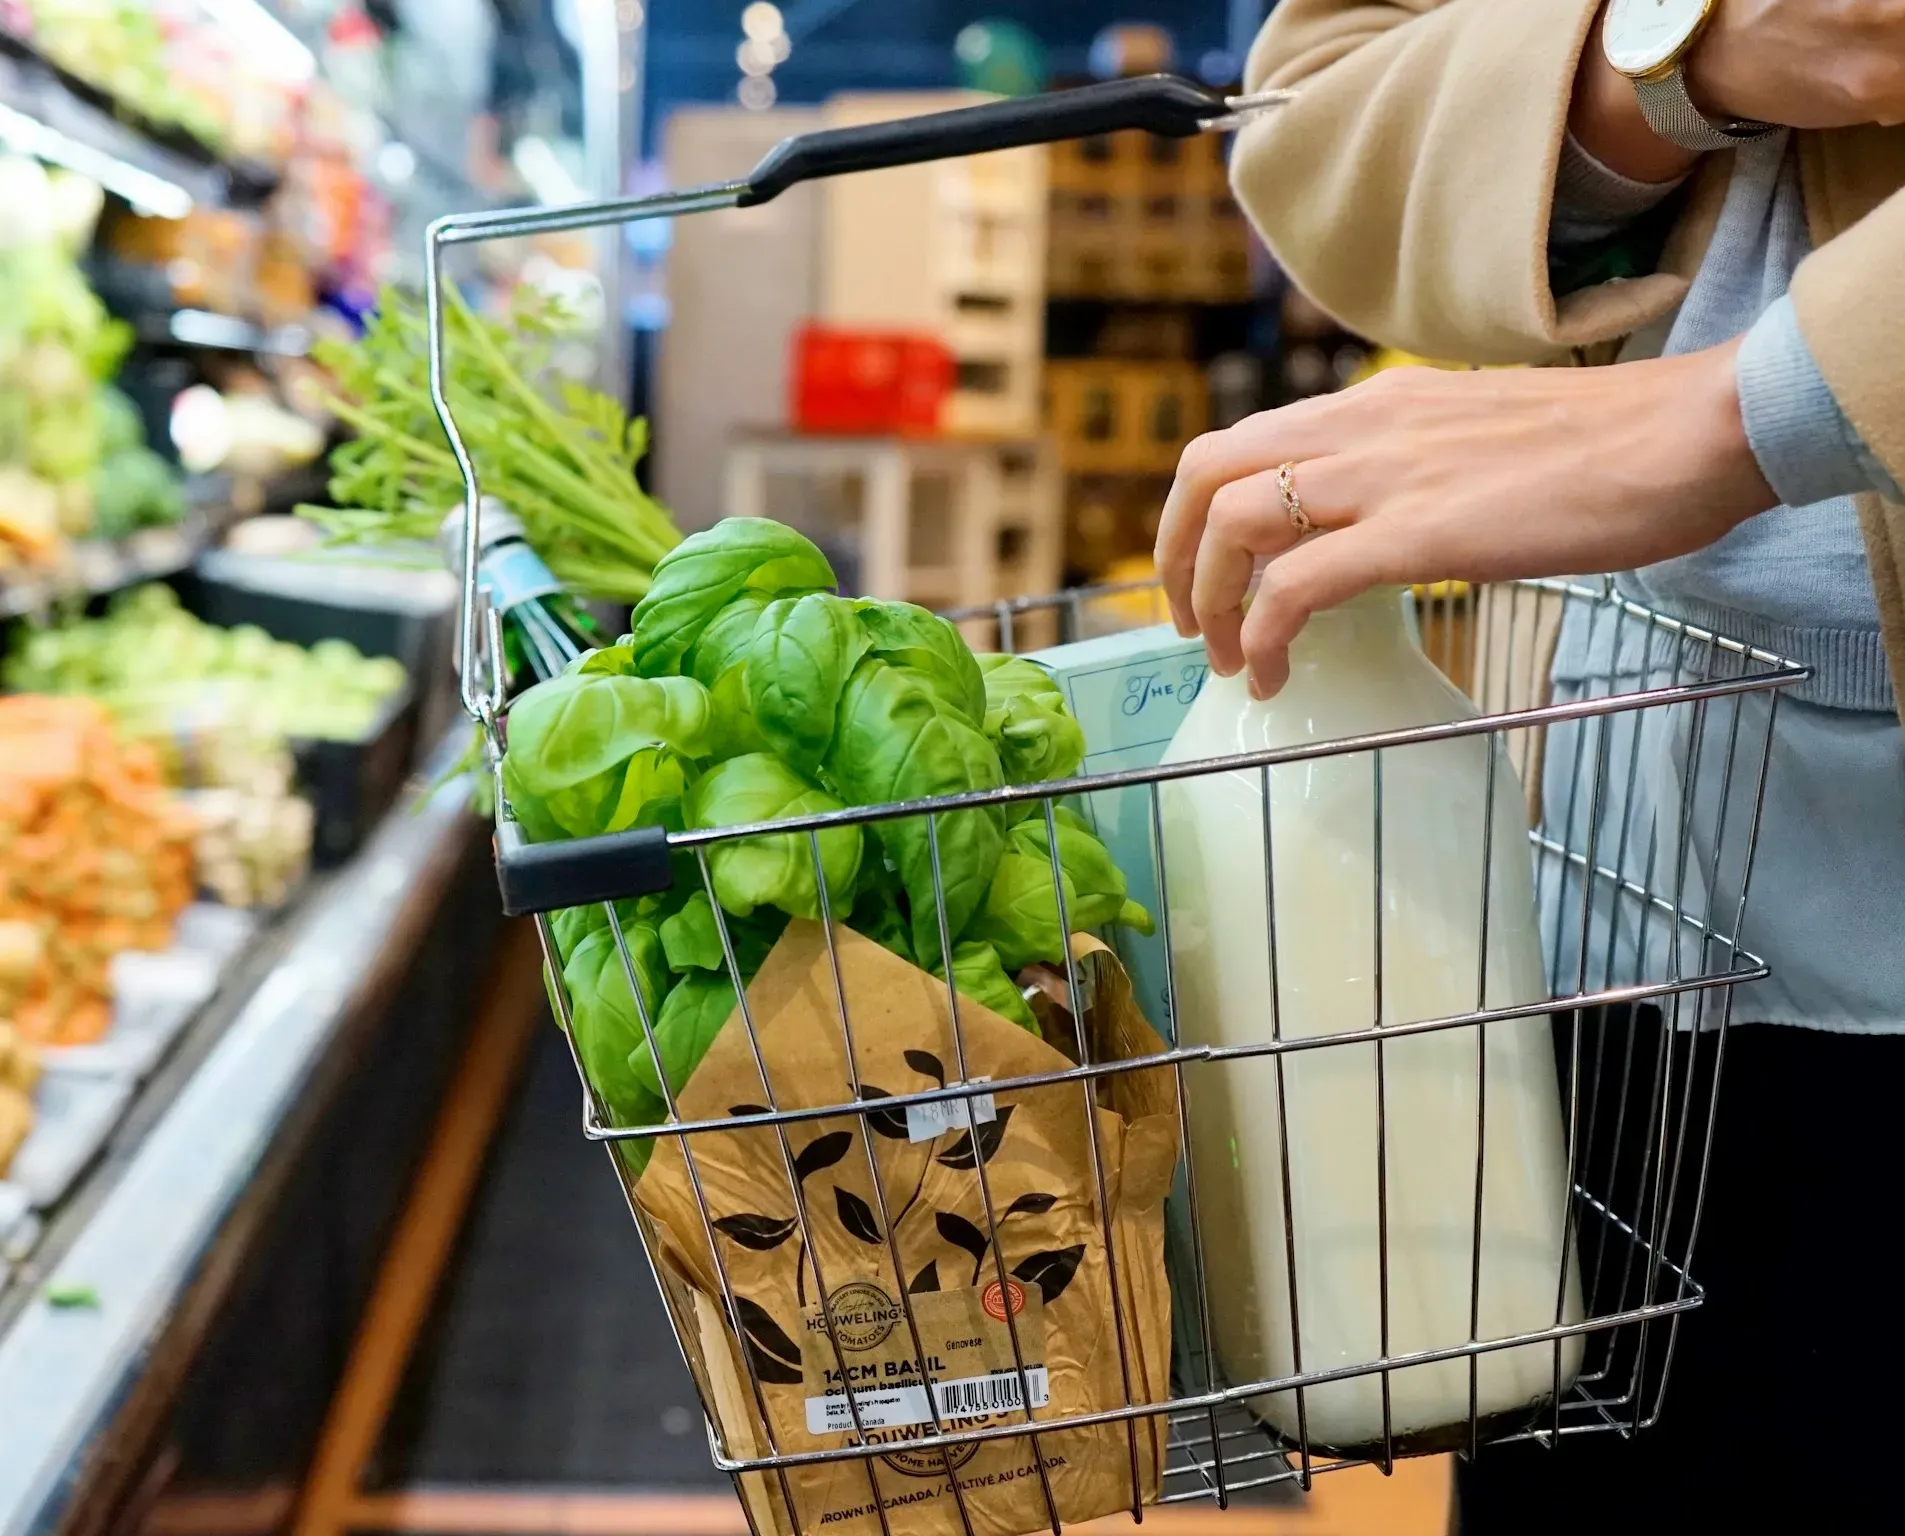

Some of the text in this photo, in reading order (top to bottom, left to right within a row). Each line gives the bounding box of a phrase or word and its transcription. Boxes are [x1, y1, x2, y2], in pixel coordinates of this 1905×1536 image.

[836, 1325, 885, 1345] TOMATOES
[945, 1337, 983, 1351] Genovese
[822, 1364, 878, 1384] 14CM
[827, 1420, 852, 1430] Product
[883, 1488, 934, 1509] CANADA
[998, 1469, 1014, 1483] AU
